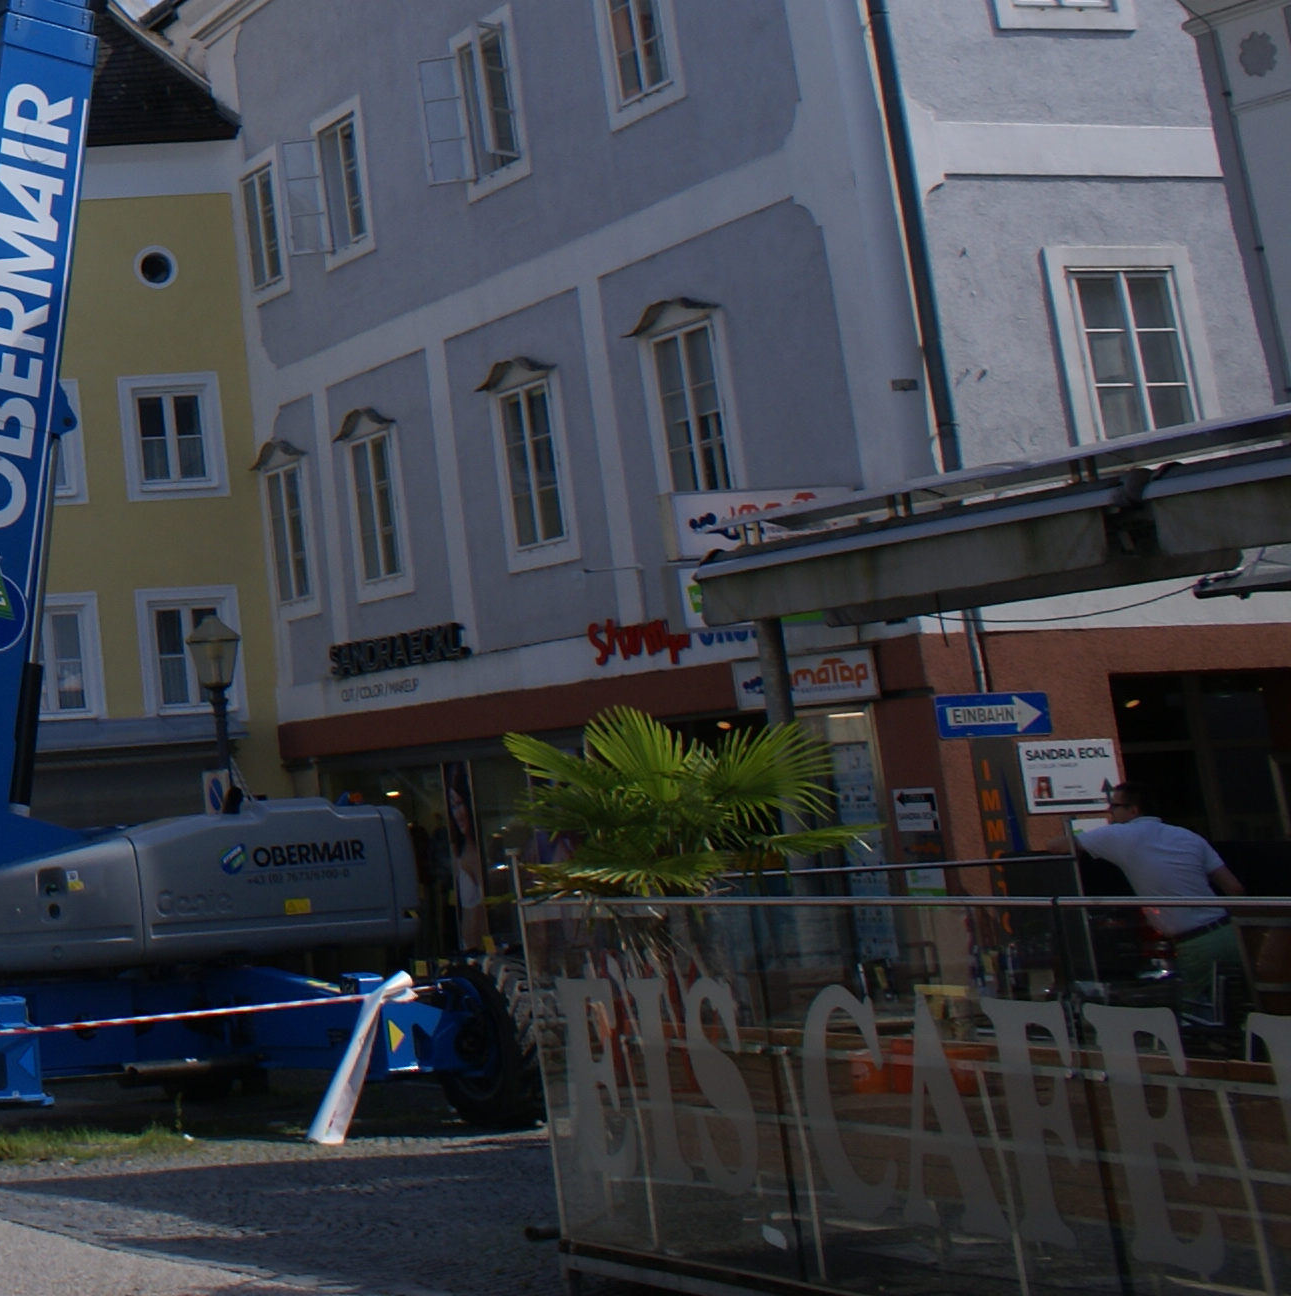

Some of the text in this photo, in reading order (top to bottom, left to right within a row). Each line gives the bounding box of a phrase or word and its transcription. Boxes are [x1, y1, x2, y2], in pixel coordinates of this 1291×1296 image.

[952, 705, 1016, 724] EINBAHN
[1025, 746, 1110, 761] SANDRA ECKL
[252, 839, 366, 868] OBERMAIR
